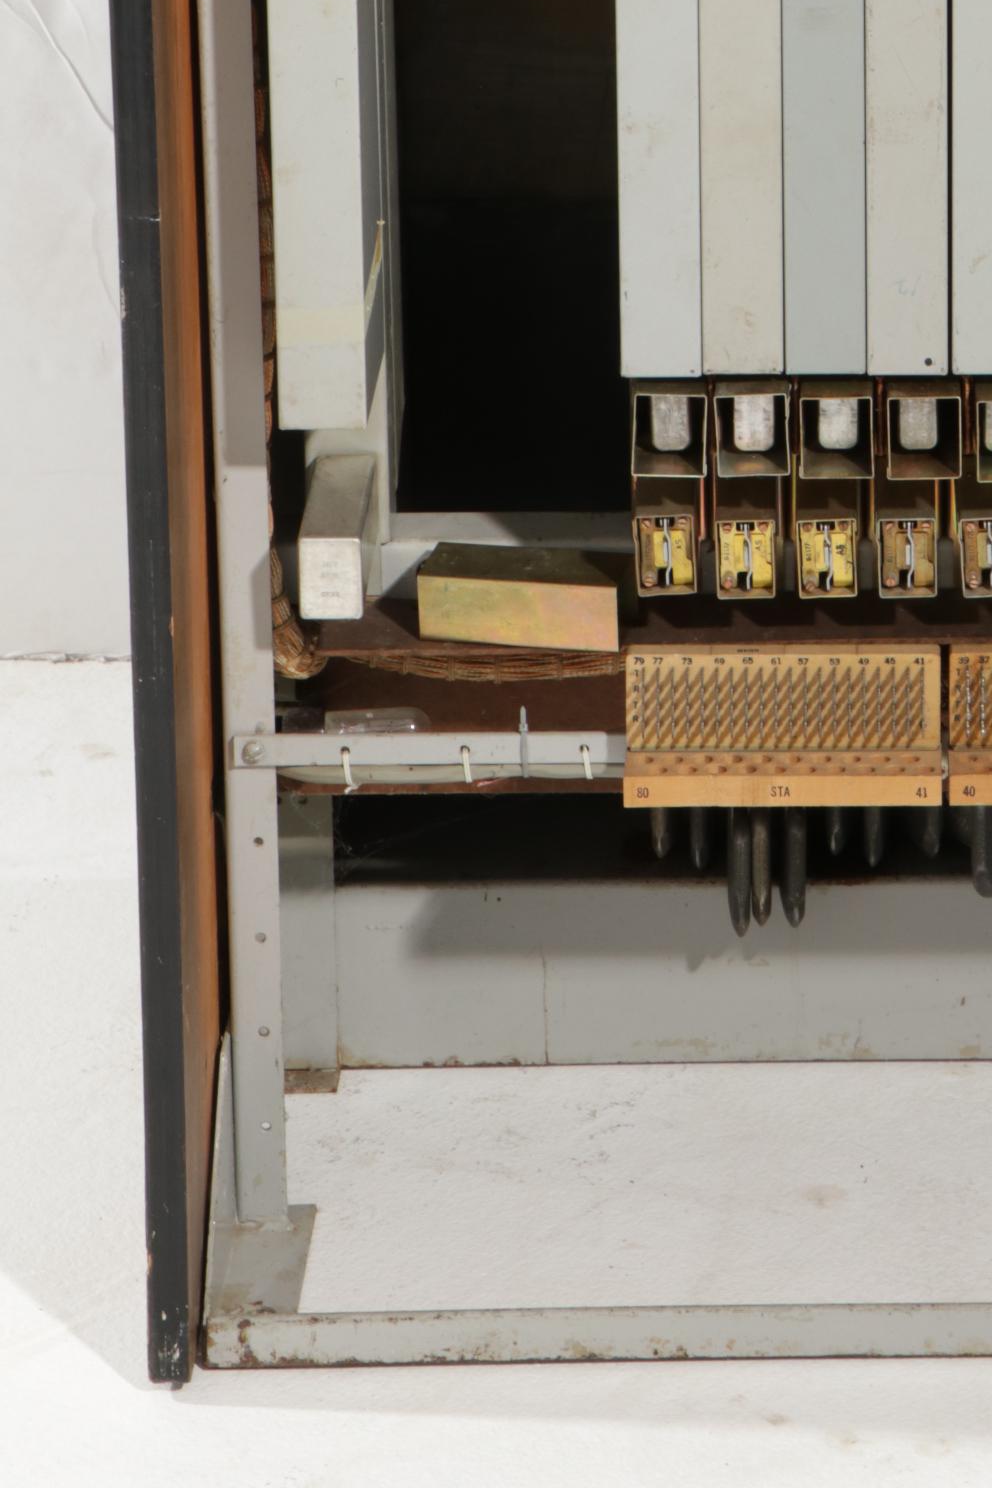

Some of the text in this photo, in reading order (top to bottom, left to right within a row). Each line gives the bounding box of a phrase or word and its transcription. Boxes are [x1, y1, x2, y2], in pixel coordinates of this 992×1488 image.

[633, 657, 645, 665] 79
[652, 657, 663, 665] 77
[636, 786, 928, 799] 80 STA 41
[963, 786, 975, 797] 40
